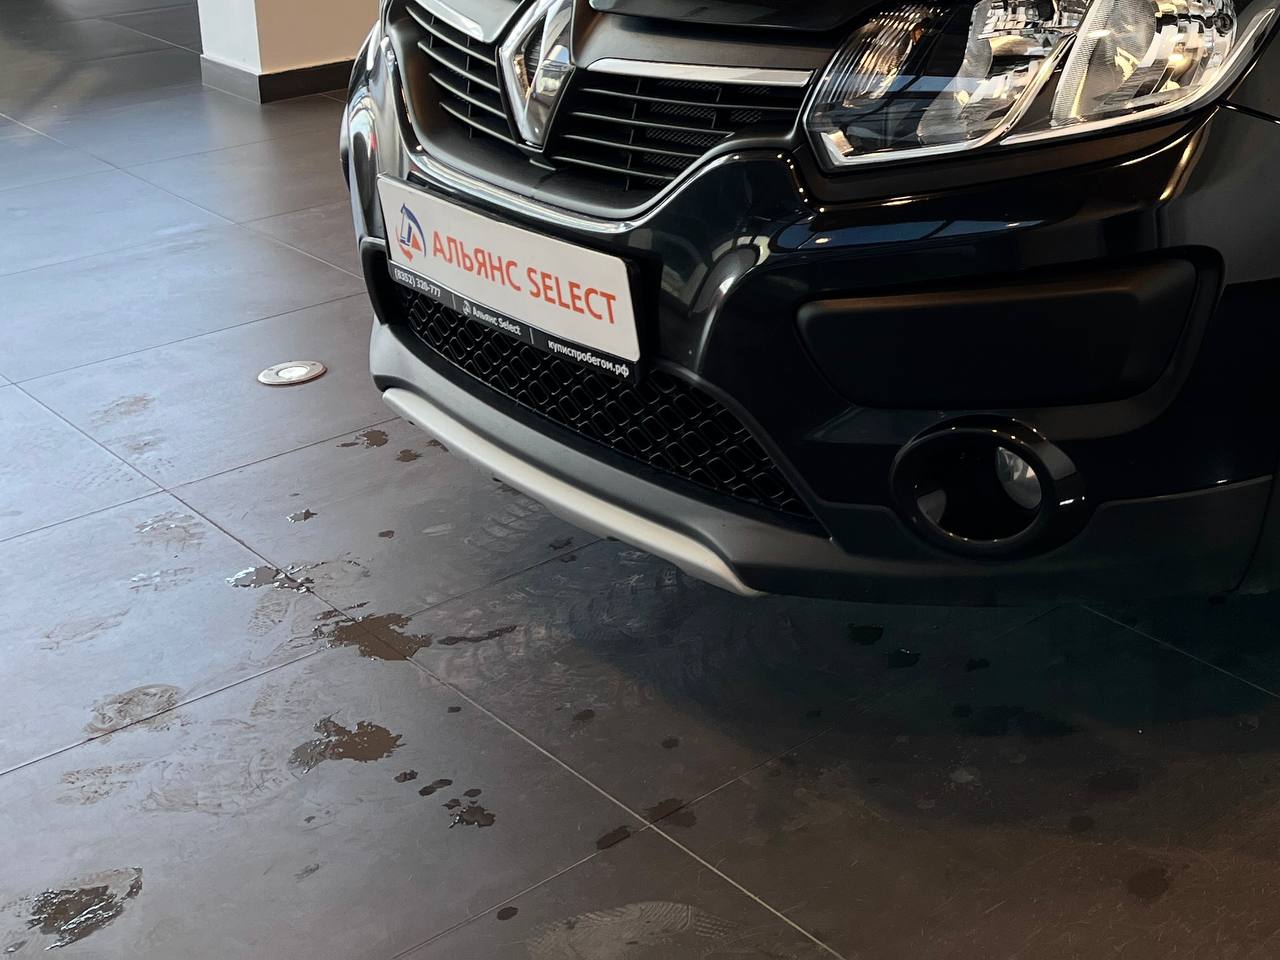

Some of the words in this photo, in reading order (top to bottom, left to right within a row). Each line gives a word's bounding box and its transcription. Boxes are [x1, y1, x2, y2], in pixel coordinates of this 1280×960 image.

[432, 231, 521, 292] АЛЬЯНС
[526, 267, 616, 325] SELECT
[498, 318, 522, 336] Select
[547, 340, 629, 378] куписпробегом.рф
